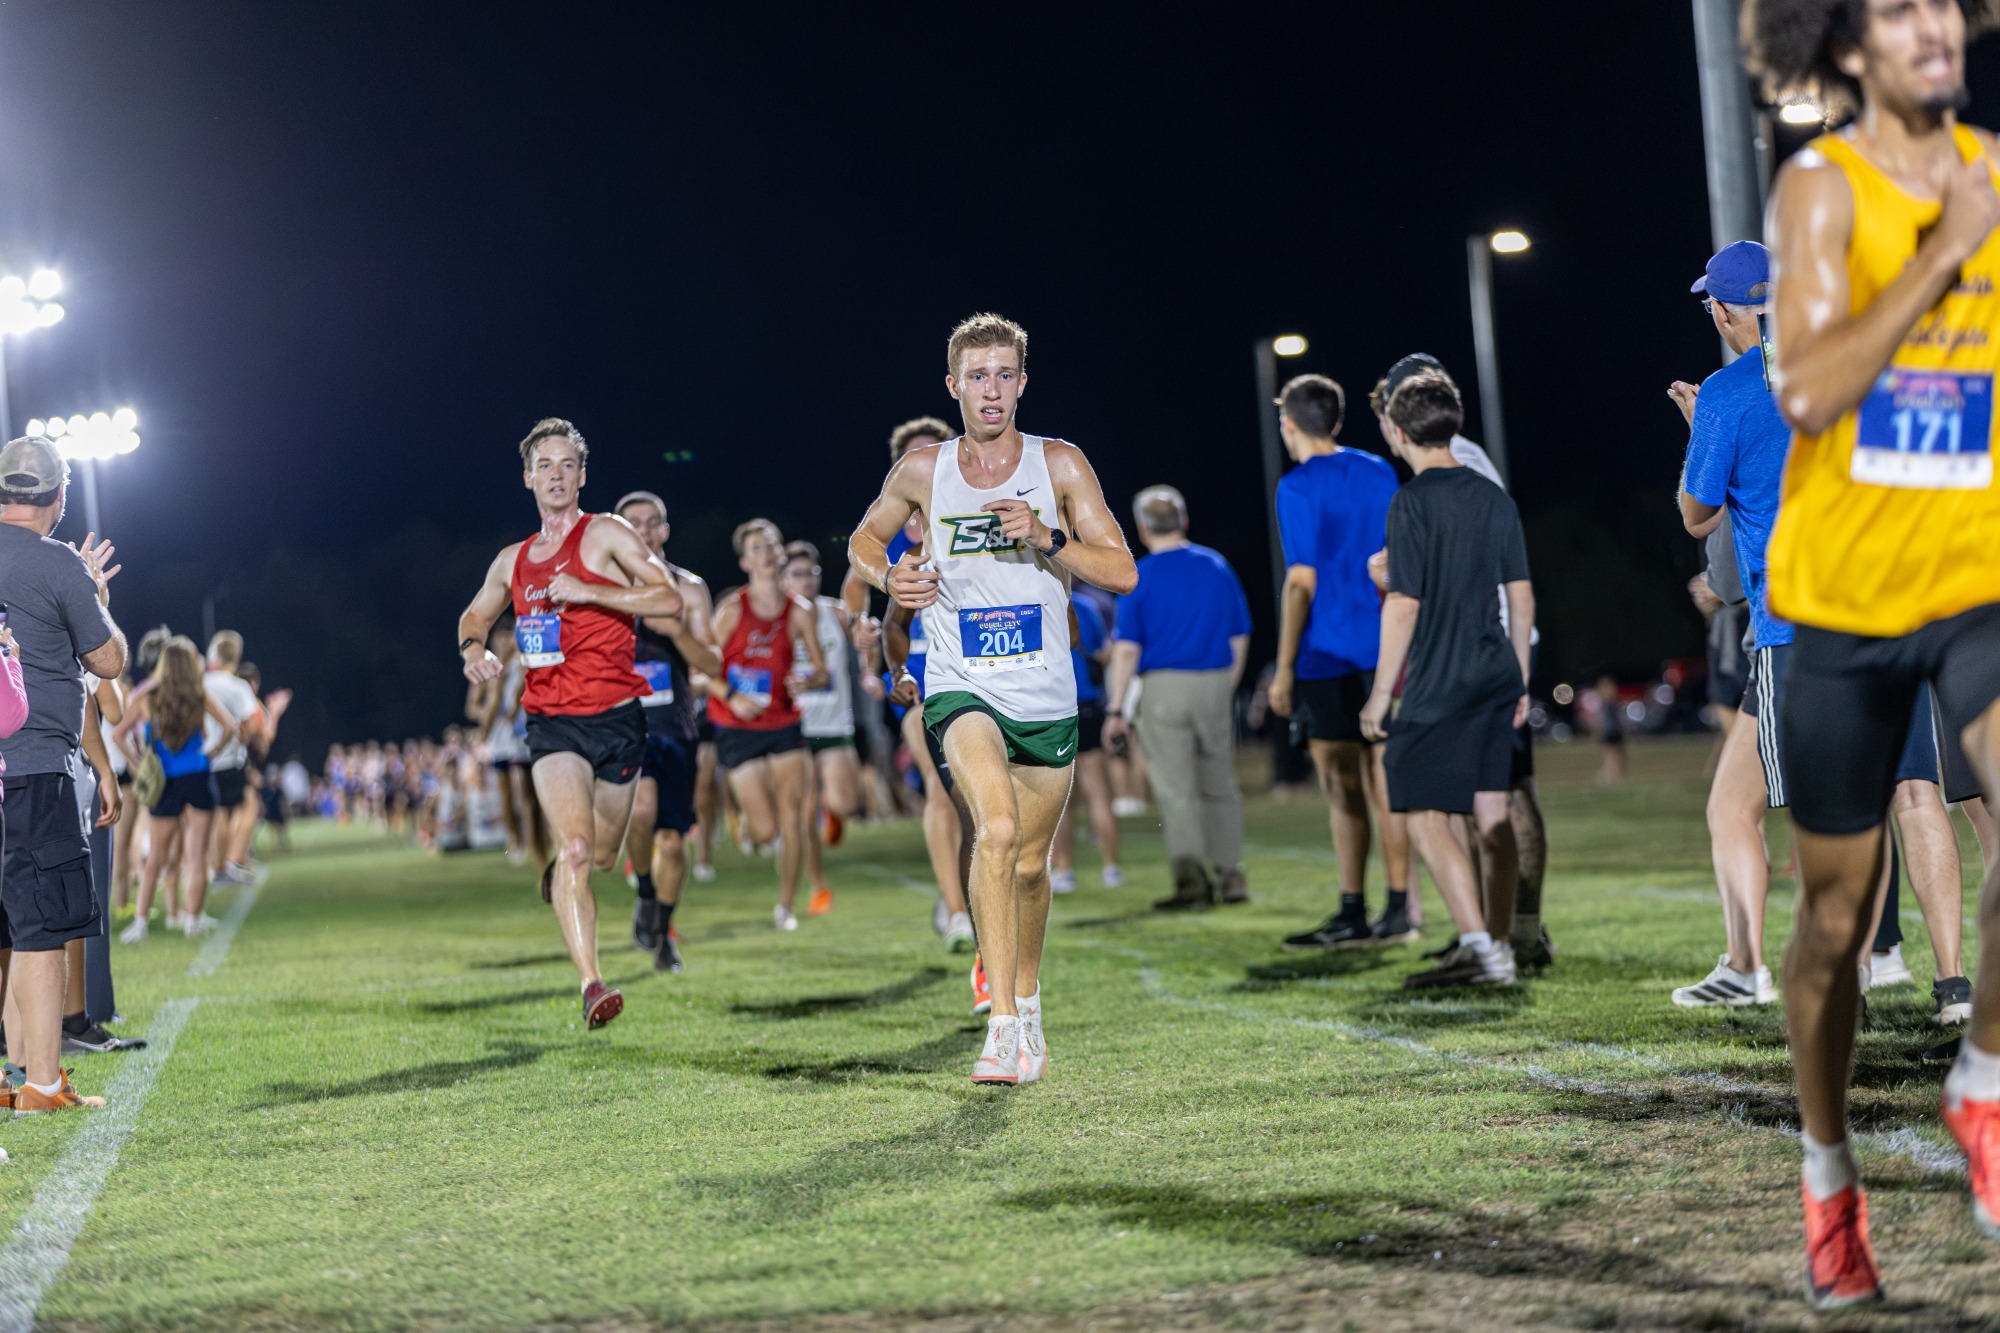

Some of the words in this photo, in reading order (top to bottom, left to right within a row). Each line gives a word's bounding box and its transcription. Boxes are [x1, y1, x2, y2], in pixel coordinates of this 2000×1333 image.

[1890, 410, 1963, 454] 171
[523, 634, 543, 654] 39
[979, 629, 1025, 656] 204
